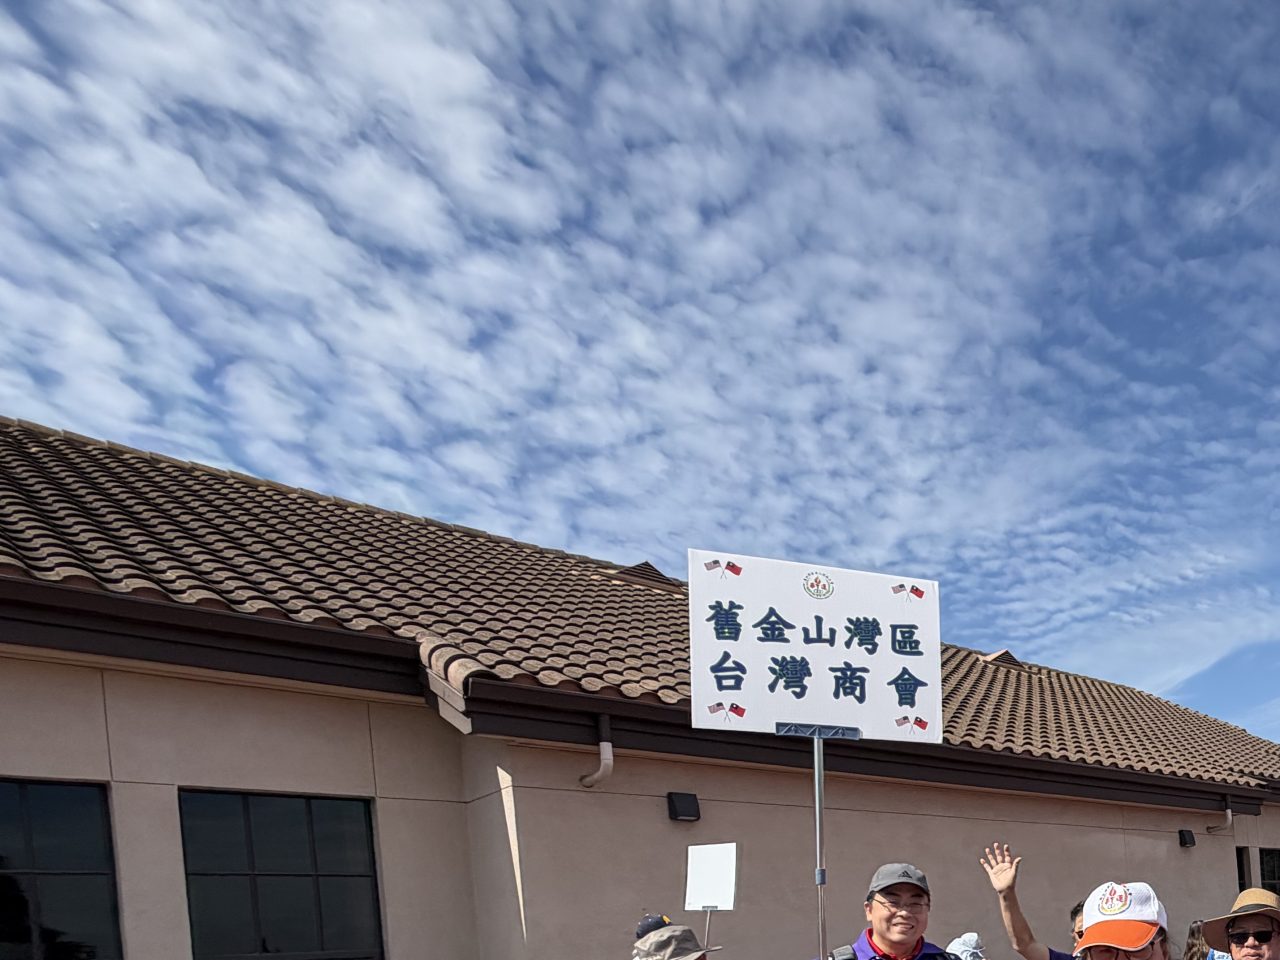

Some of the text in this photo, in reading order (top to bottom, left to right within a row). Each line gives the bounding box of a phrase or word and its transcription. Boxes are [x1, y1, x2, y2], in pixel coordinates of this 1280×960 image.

[705, 600, 925, 657] 舊金山灣區
[709, 650, 929, 709] 台灣商會
